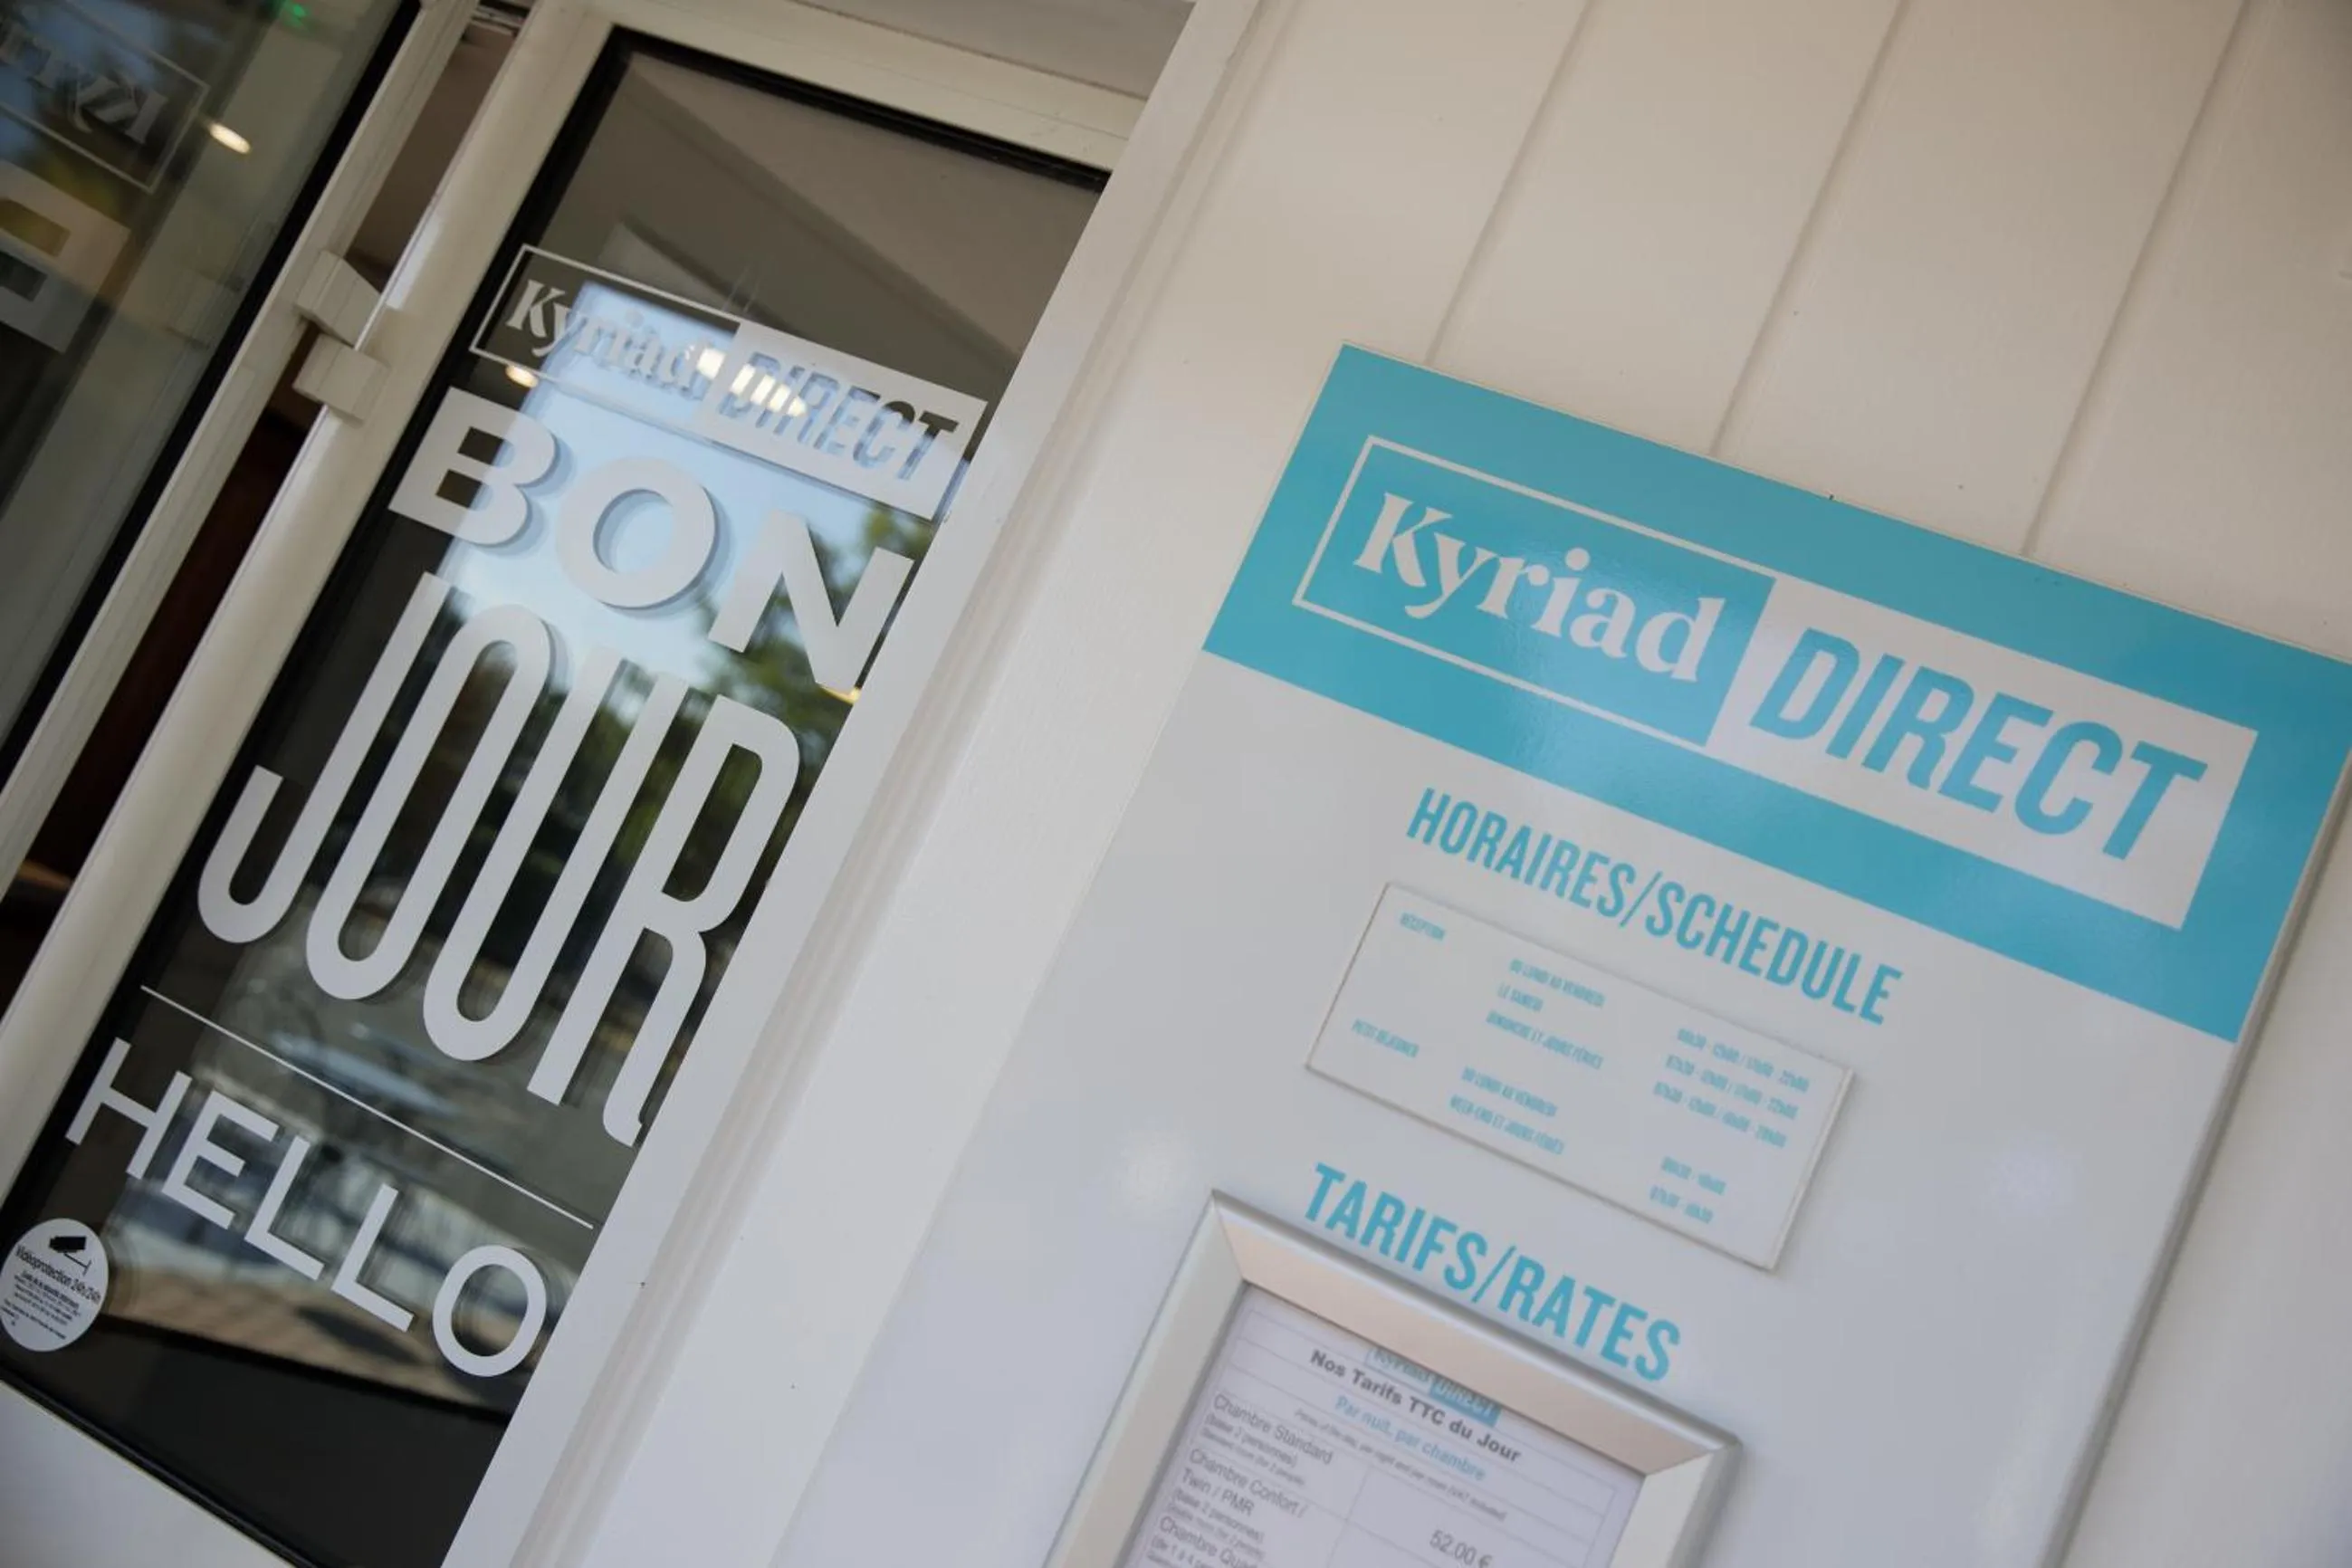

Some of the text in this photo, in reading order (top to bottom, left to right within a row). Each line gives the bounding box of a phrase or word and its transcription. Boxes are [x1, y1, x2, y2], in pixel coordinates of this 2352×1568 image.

[506, 280, 958, 482] Kyriad DIRECT
[388, 387, 913, 693] BON
[1353, 492, 2208, 861] Kyriad DIRECT
[197, 572, 800, 1146] JOUR
[1407, 787, 1904, 1025] HORAIRES/SCHEDULE
[64, 1037, 546, 1377] HELLO
[1305, 1162, 1681, 1382] TARIFS/RATES
[1190, 1448, 1249, 1489] Chambre
[1213, 1393, 1334, 1466] Chambre Standard
[1311, 1349, 1522, 1463] Nos Tarifs TTC du Jour
[1335, 1395, 1359, 1419] Par
[1394, 1429, 1420, 1449] par
[1422, 1440, 1486, 1481] chambre
[1160, 1515, 1219, 1557] Chambre
[1182, 1468, 1212, 1494] Twin
[1221, 1489, 1256, 1517] PMR
[1429, 1529, 1493, 1568] 52.00 €
